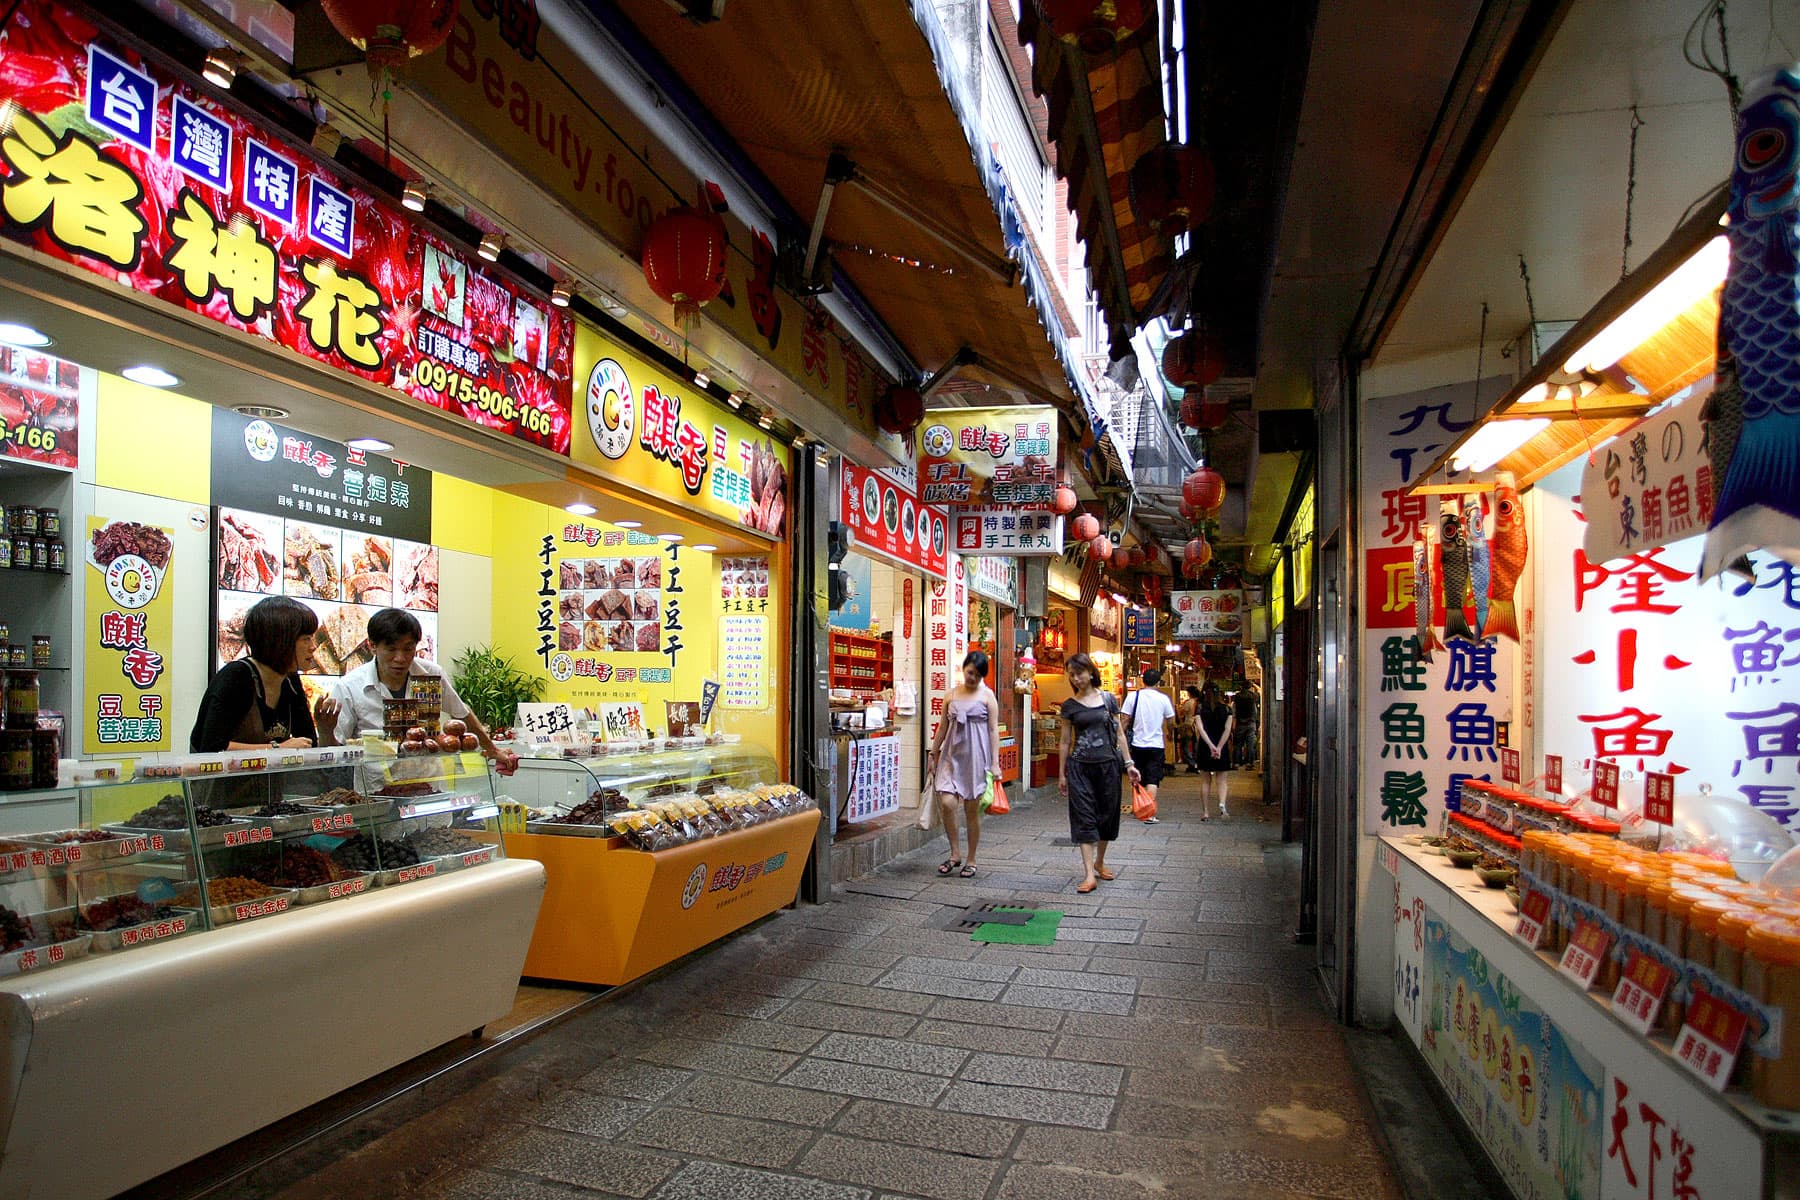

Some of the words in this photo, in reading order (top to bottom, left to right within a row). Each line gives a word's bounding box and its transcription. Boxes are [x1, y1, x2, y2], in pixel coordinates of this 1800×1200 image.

[101, 70, 348, 248] 台灣特產
[2, 117, 384, 370] 洛神花
[416, 360, 552, 437] 0915-906-166
[641, 384, 708, 492] 麒香
[959, 424, 1010, 458] 麒香
[1015, 423, 1050, 439] 豆干
[283, 436, 338, 478] 麒香
[713, 425, 752, 473] 豆干
[1015, 439, 1050, 456] 菩提素
[927, 462, 976, 481] 手工
[1603, 420, 1711, 500] 台灣の
[993, 464, 1053, 483] 豆干
[343, 468, 410, 509] 菩提素
[924, 483, 972, 502] 碳烤
[993, 484, 1053, 503] 菩提素
[352, 511, 367, 524] 分享
[563, 523, 601, 547] 麒香
[604, 531, 625, 546] 豆干
[984, 534, 1051, 548] 手工魚丸
[536, 534, 558, 670] 手工豆干
[723, 599, 769, 613] 手工豆干
[100, 611, 164, 688] 麒香
[574, 658, 613, 683] 麒香
[615, 667, 638, 682] 豆干
[639, 667, 672, 683] 菩提素
[99, 694, 162, 718] 豆干
[98, 717, 162, 743] 菩提素
[1380, 635, 1429, 829] 鮭魚鬆
[312, 813, 355, 832] 愛文芒果
[119, 834, 165, 856] 小紅莓
[224, 826, 273, 848] 凍頂烏梅
[329, 880, 365, 899] 洛神花
[236, 898, 288, 921] 野生金桔
[122, 918, 187, 946] 薄荷金桔
[21, 944, 65, 969] 茶梅
